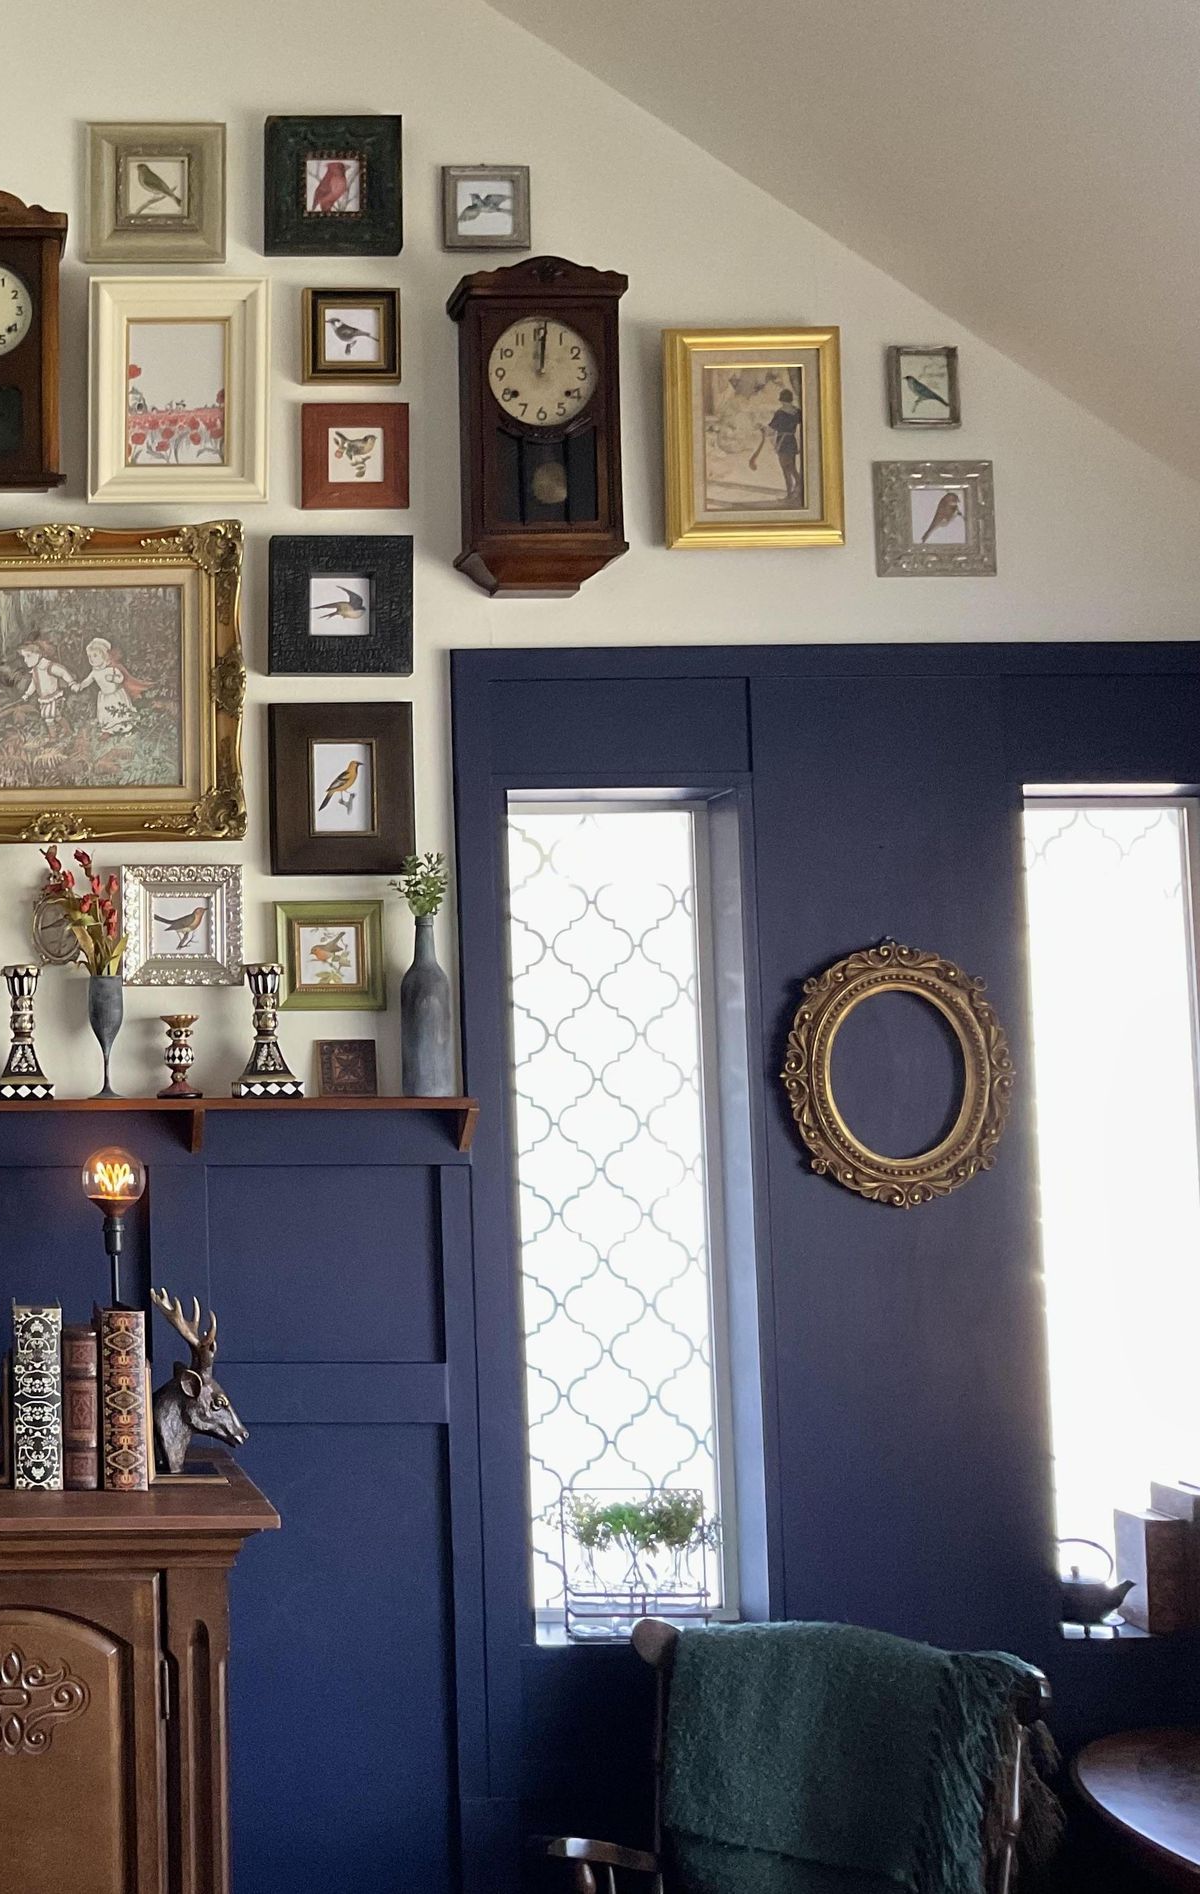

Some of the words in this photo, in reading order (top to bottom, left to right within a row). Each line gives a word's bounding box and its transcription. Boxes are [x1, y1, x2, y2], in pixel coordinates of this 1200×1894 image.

[1, 277, 5, 287] 1
[11, 290, 19, 299] 2
[16, 306, 23, 316] 3
[10, 323, 18, 332] 4
[516, 333, 524, 346] 11
[560, 332, 563, 346] 1
[500, 348, 514, 360] 10
[570, 346, 581, 360] 2
[495, 367, 506, 381] 9
[576, 366, 587, 381] 3
[501, 388, 511, 402] 8
[570, 388, 582, 401] 4
[518, 403, 528, 417] 7
[536, 406, 547, 421] 6
[555, 402, 566, 417] 5
